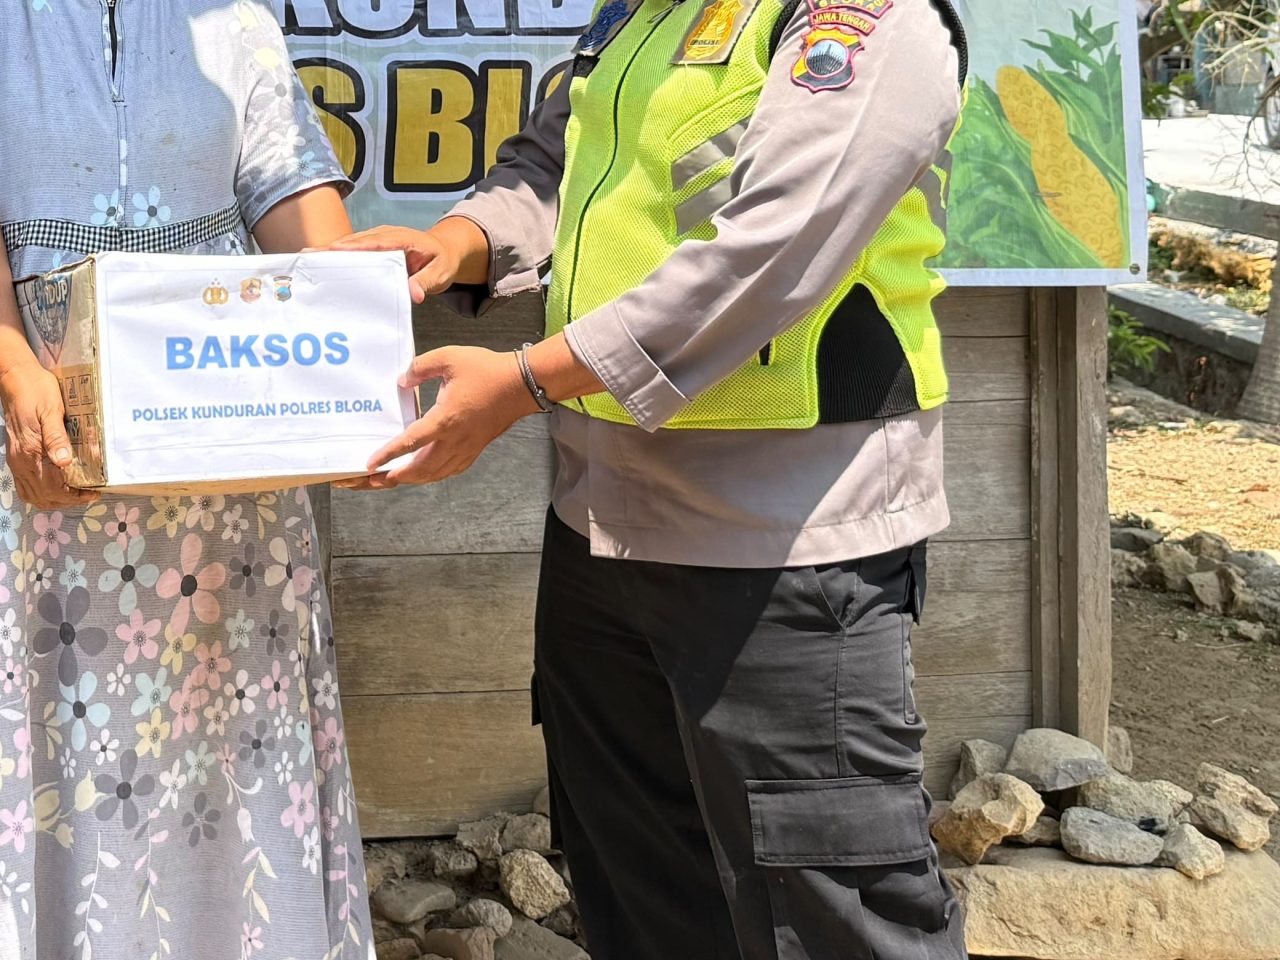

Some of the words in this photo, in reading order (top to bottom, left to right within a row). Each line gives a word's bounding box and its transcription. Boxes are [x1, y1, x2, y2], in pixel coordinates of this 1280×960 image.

[814, 12, 837, 23] JAWA
[838, 13, 871, 32] TENGAH
[166, 332, 350, 370] BAKSOS
[132, 406, 188, 422] POLSEK
[191, 403, 276, 420] KUNDURAN
[280, 399, 332, 416] POLRES
[335, 398, 383, 413] BLORA
